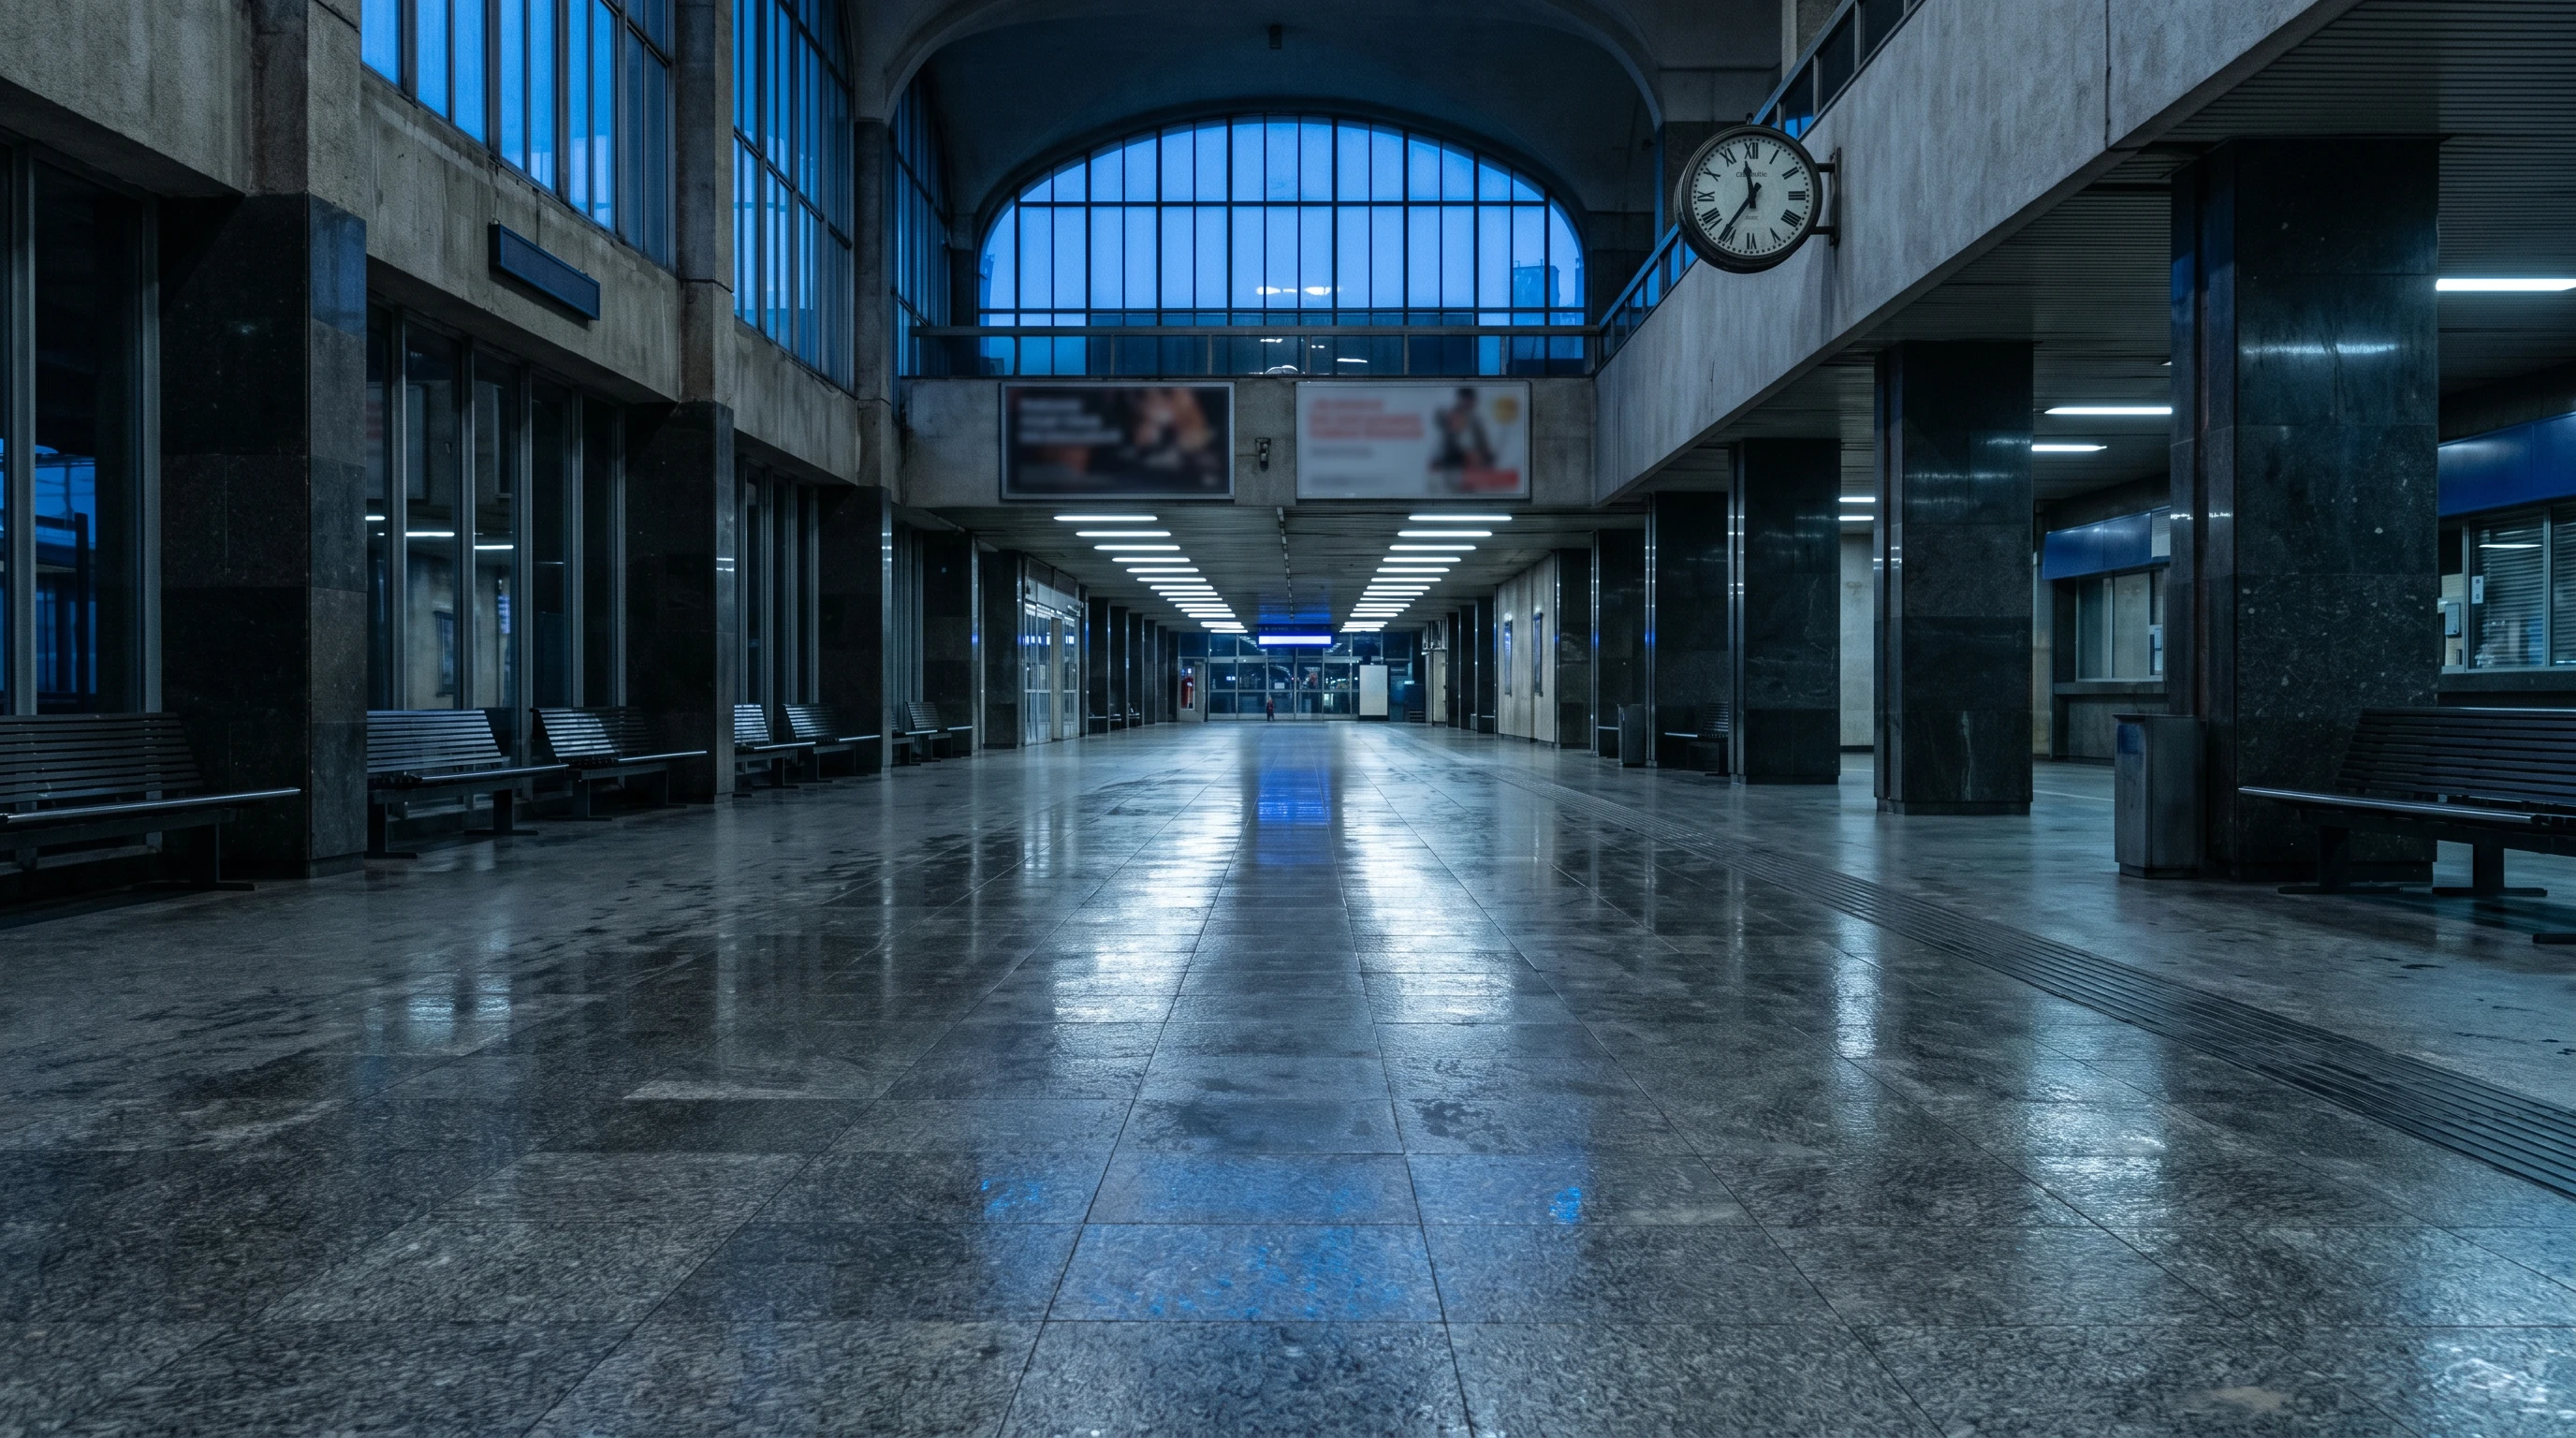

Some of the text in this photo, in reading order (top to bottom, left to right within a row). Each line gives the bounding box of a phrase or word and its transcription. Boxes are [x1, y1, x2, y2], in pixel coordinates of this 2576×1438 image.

[1744, 142, 1759, 159] XII
[1769, 149, 1779, 165] I
[1702, 168, 1720, 182] X
[1782, 167, 1799, 180] II
[1788, 191, 1806, 200] III
